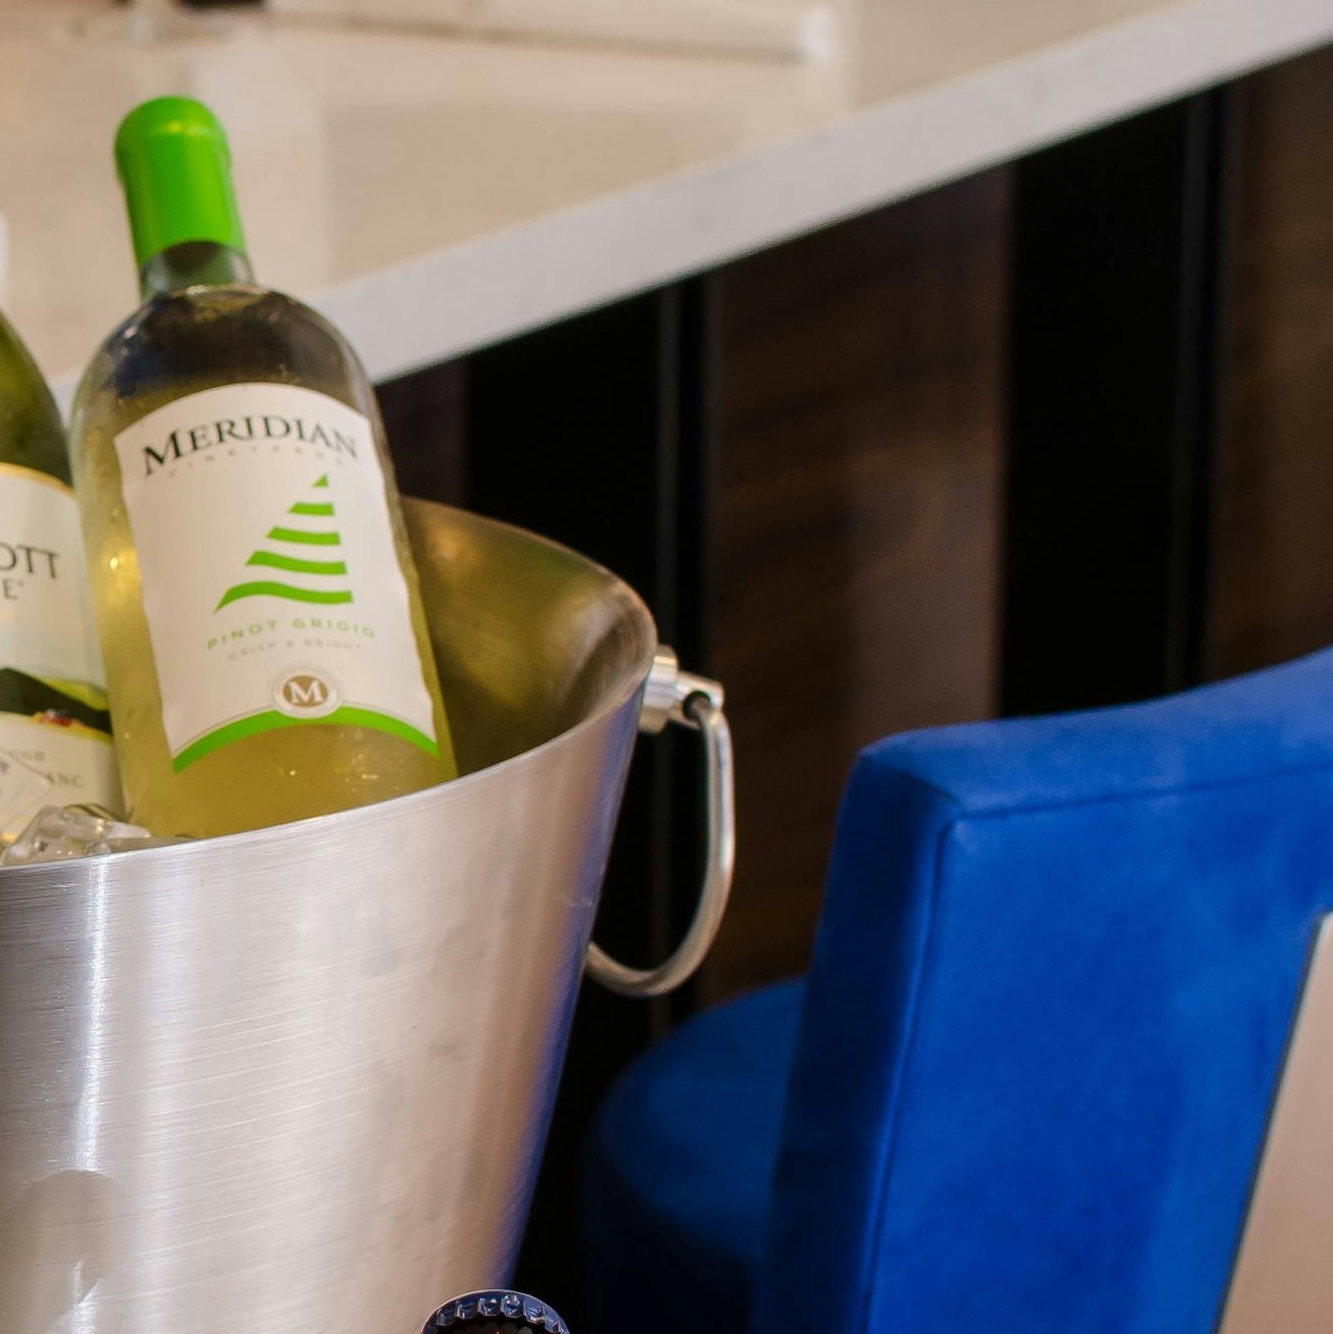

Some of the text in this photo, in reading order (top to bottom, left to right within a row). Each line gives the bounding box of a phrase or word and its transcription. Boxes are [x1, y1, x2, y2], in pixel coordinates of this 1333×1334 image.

[141, 414, 359, 478] MERIDIAN
[206, 618, 376, 650] PINOT GRIGIO
[286, 679, 326, 705] M
